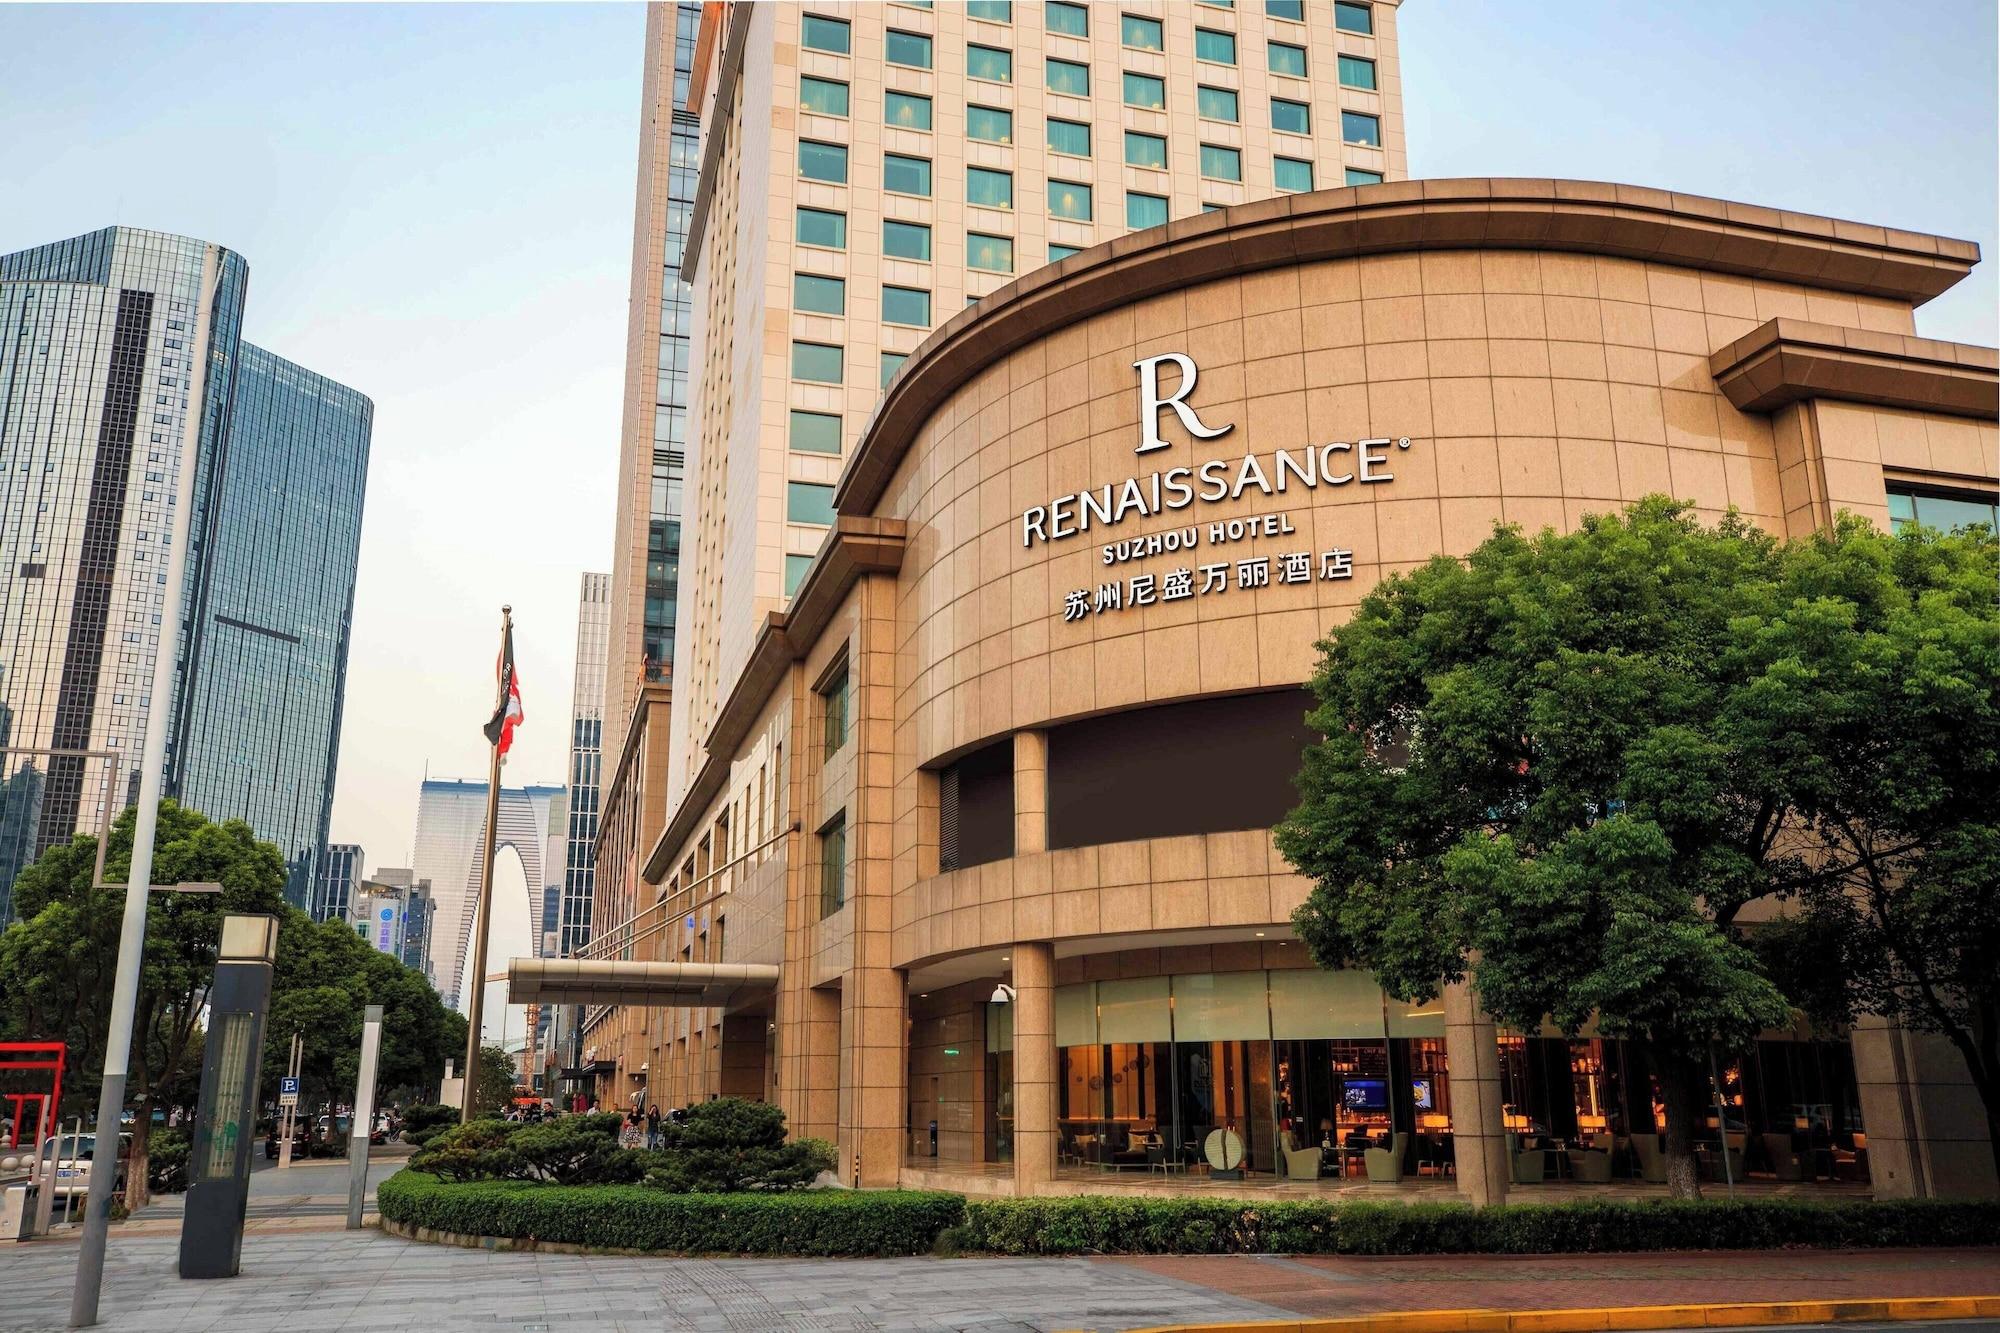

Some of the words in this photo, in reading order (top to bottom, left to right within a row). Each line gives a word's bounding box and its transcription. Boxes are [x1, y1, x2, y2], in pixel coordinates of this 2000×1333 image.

[1132, 352, 1235, 454] R
[1103, 528, 1199, 565] SUZHOU
[1209, 513, 1296, 544] HOTEL
[1064, 547, 1354, 622] 苏州尼盛万丽酒店
[284, 1080, 294, 1091] P
